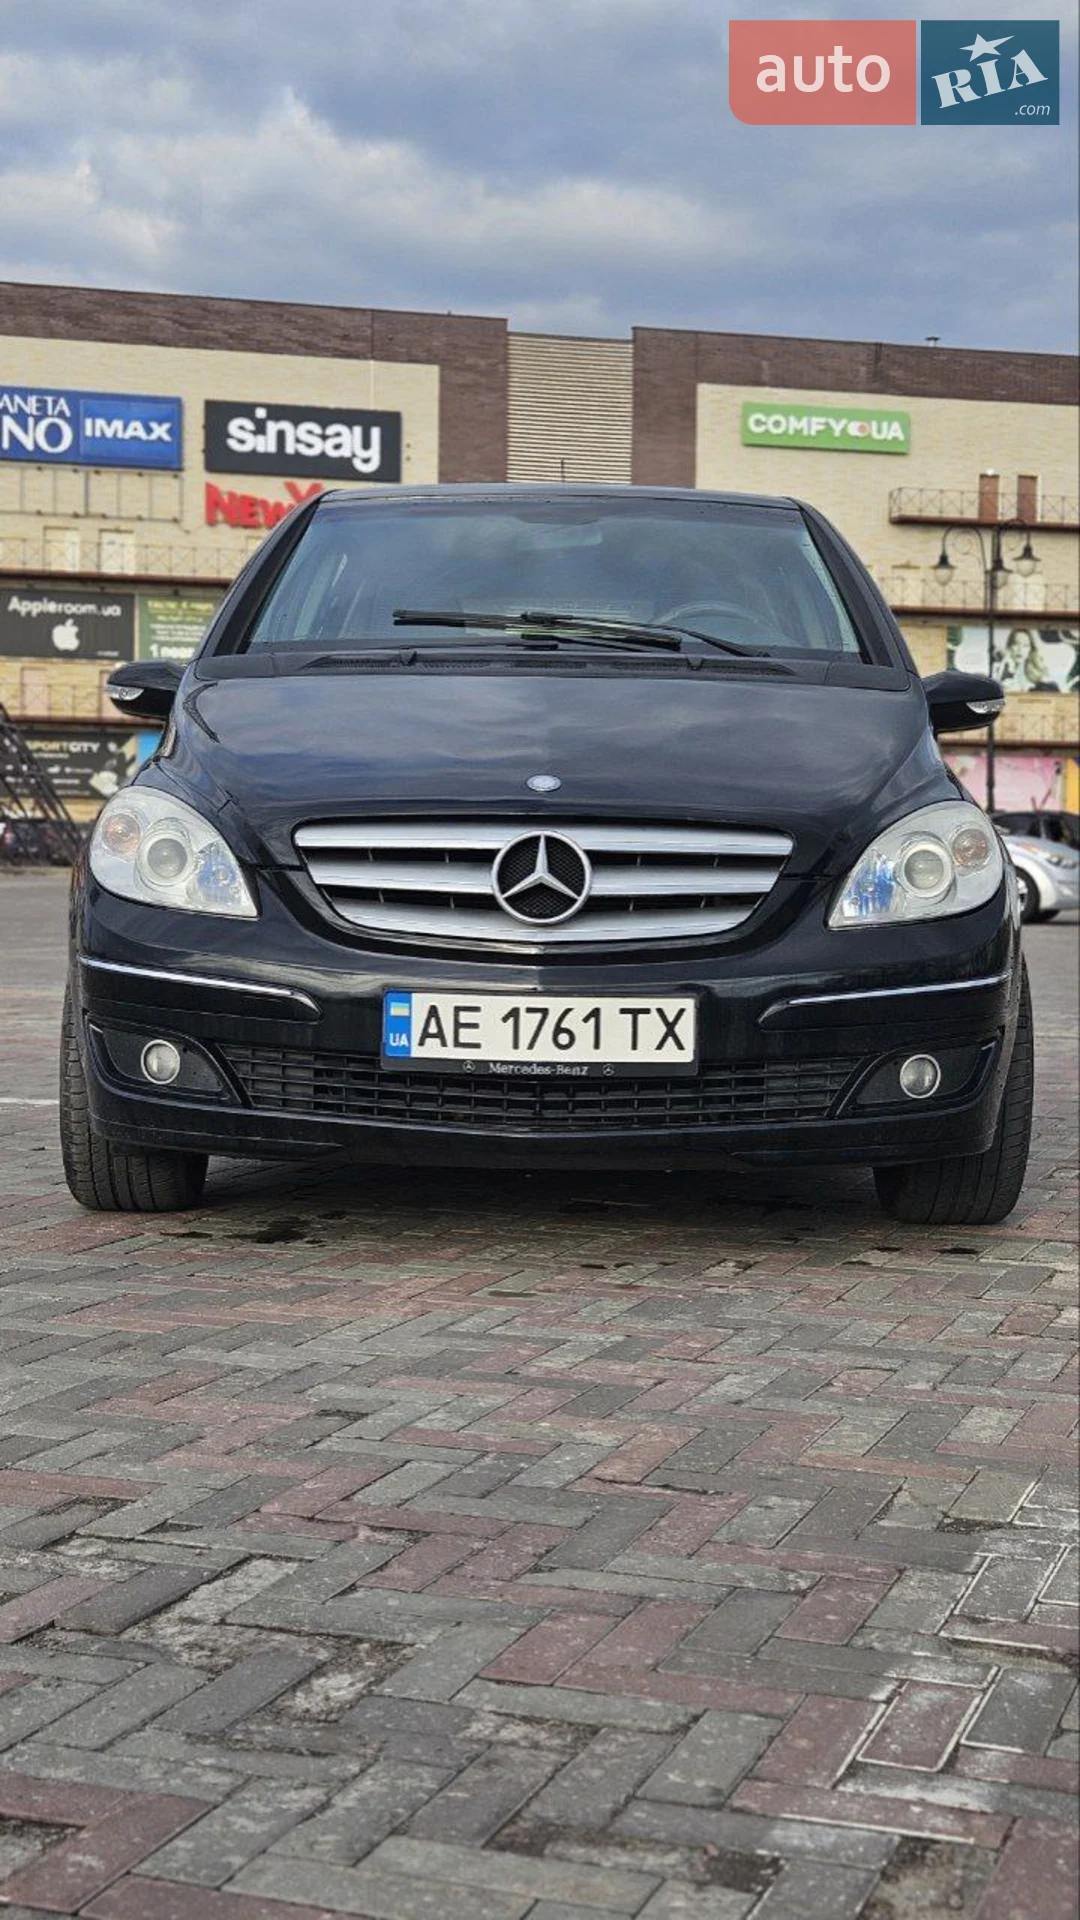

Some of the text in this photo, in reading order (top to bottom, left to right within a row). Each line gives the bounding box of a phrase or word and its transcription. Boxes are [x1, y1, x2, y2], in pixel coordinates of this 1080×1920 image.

[85, 417, 173, 442] IMAX
[748, 412, 849, 437] COMFY
[226, 406, 382, 474] sinsay
[8, 596, 122, 617] Appleroom.ua
[389, 1033, 410, 1047] UA
[417, 1004, 687, 1051] AE 1761 TX
[488, 1062, 589, 1076] Mercedes-Benz
